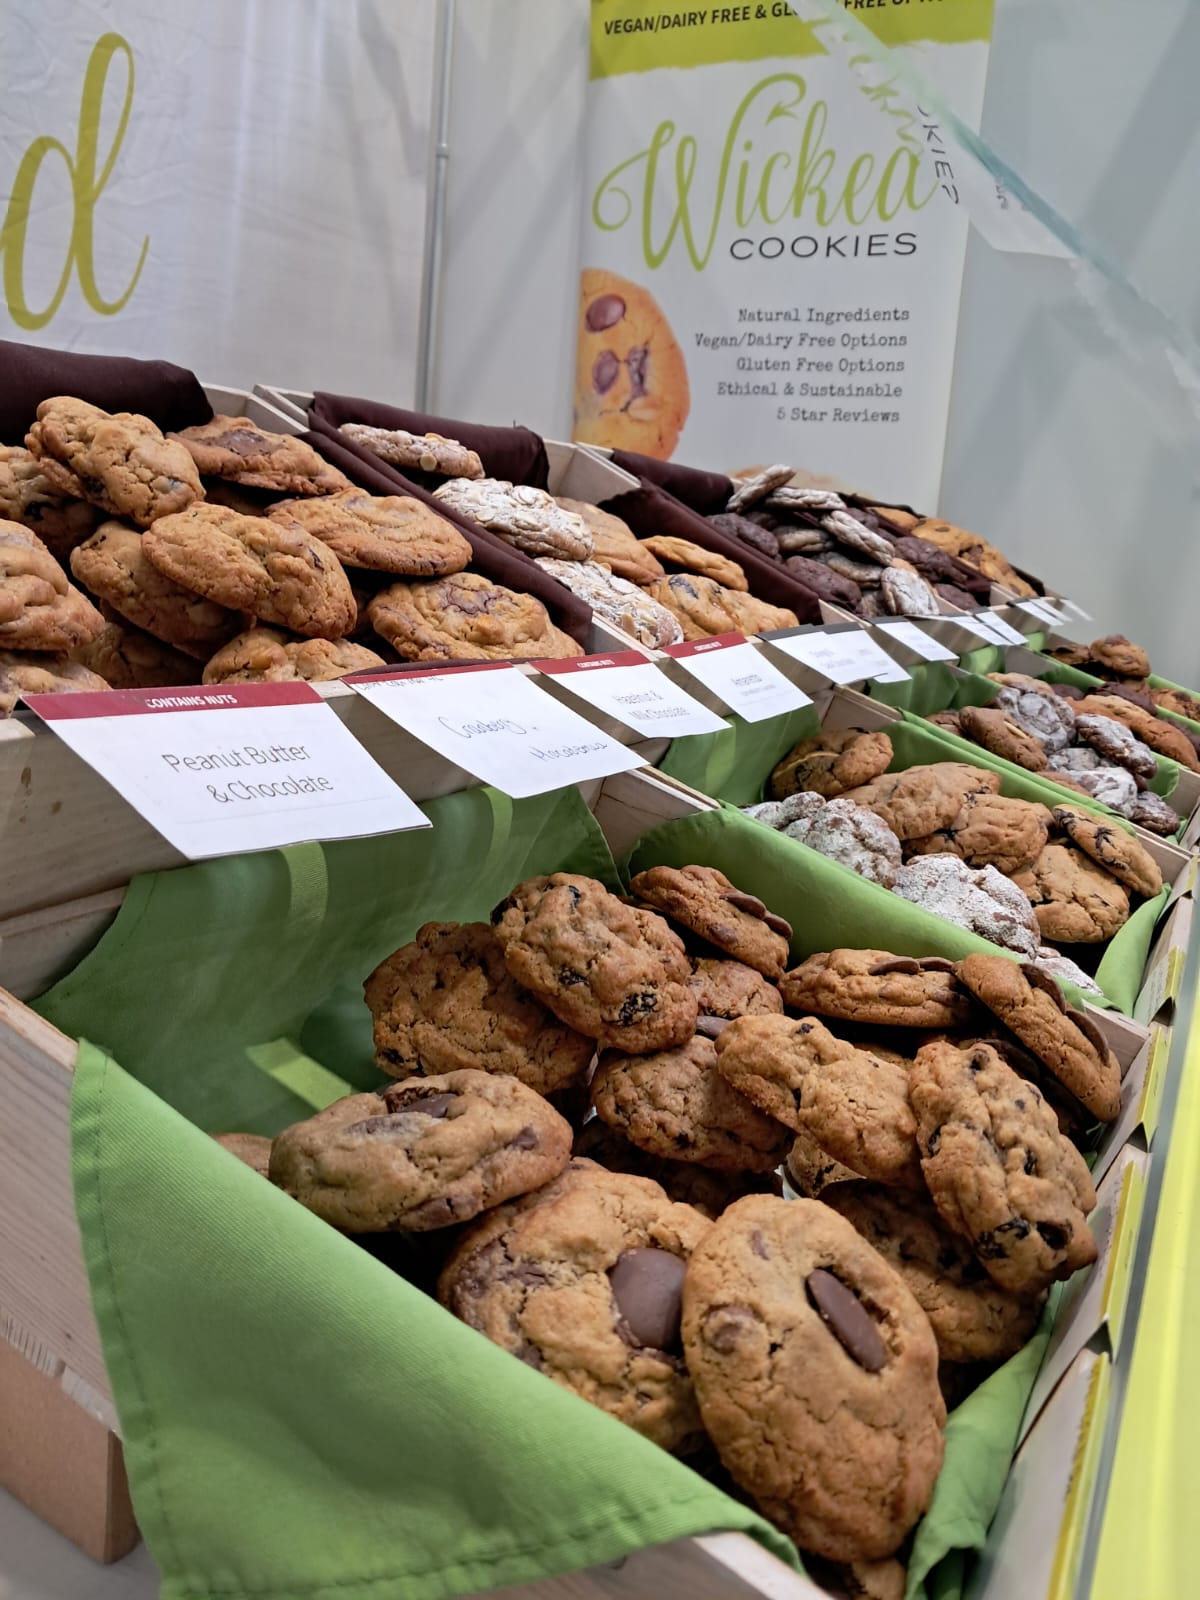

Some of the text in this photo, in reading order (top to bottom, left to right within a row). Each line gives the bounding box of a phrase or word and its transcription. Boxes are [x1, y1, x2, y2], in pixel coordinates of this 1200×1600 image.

[604, 10, 707, 35] VEGAN/DAIRY
[711, 6, 750, 24] FREE
[755, 4, 766, 19] &
[730, 232, 918, 260] COOKIES
[738, 307, 910, 325] Natural Ingredients
[695, 332, 908, 350] Vegan/Dairy Free Options
[736, 357, 905, 374] Gluten Free Options
[717, 382, 902, 398] Ethical & Sustainable
[790, 407, 827, 422] Star
[832, 408, 900, 423] Reviews
[145, 694, 238, 709] CONTAINS NUTS
[161, 744, 311, 773] Peanut Butter
[206, 775, 334, 804] & Chocolate
